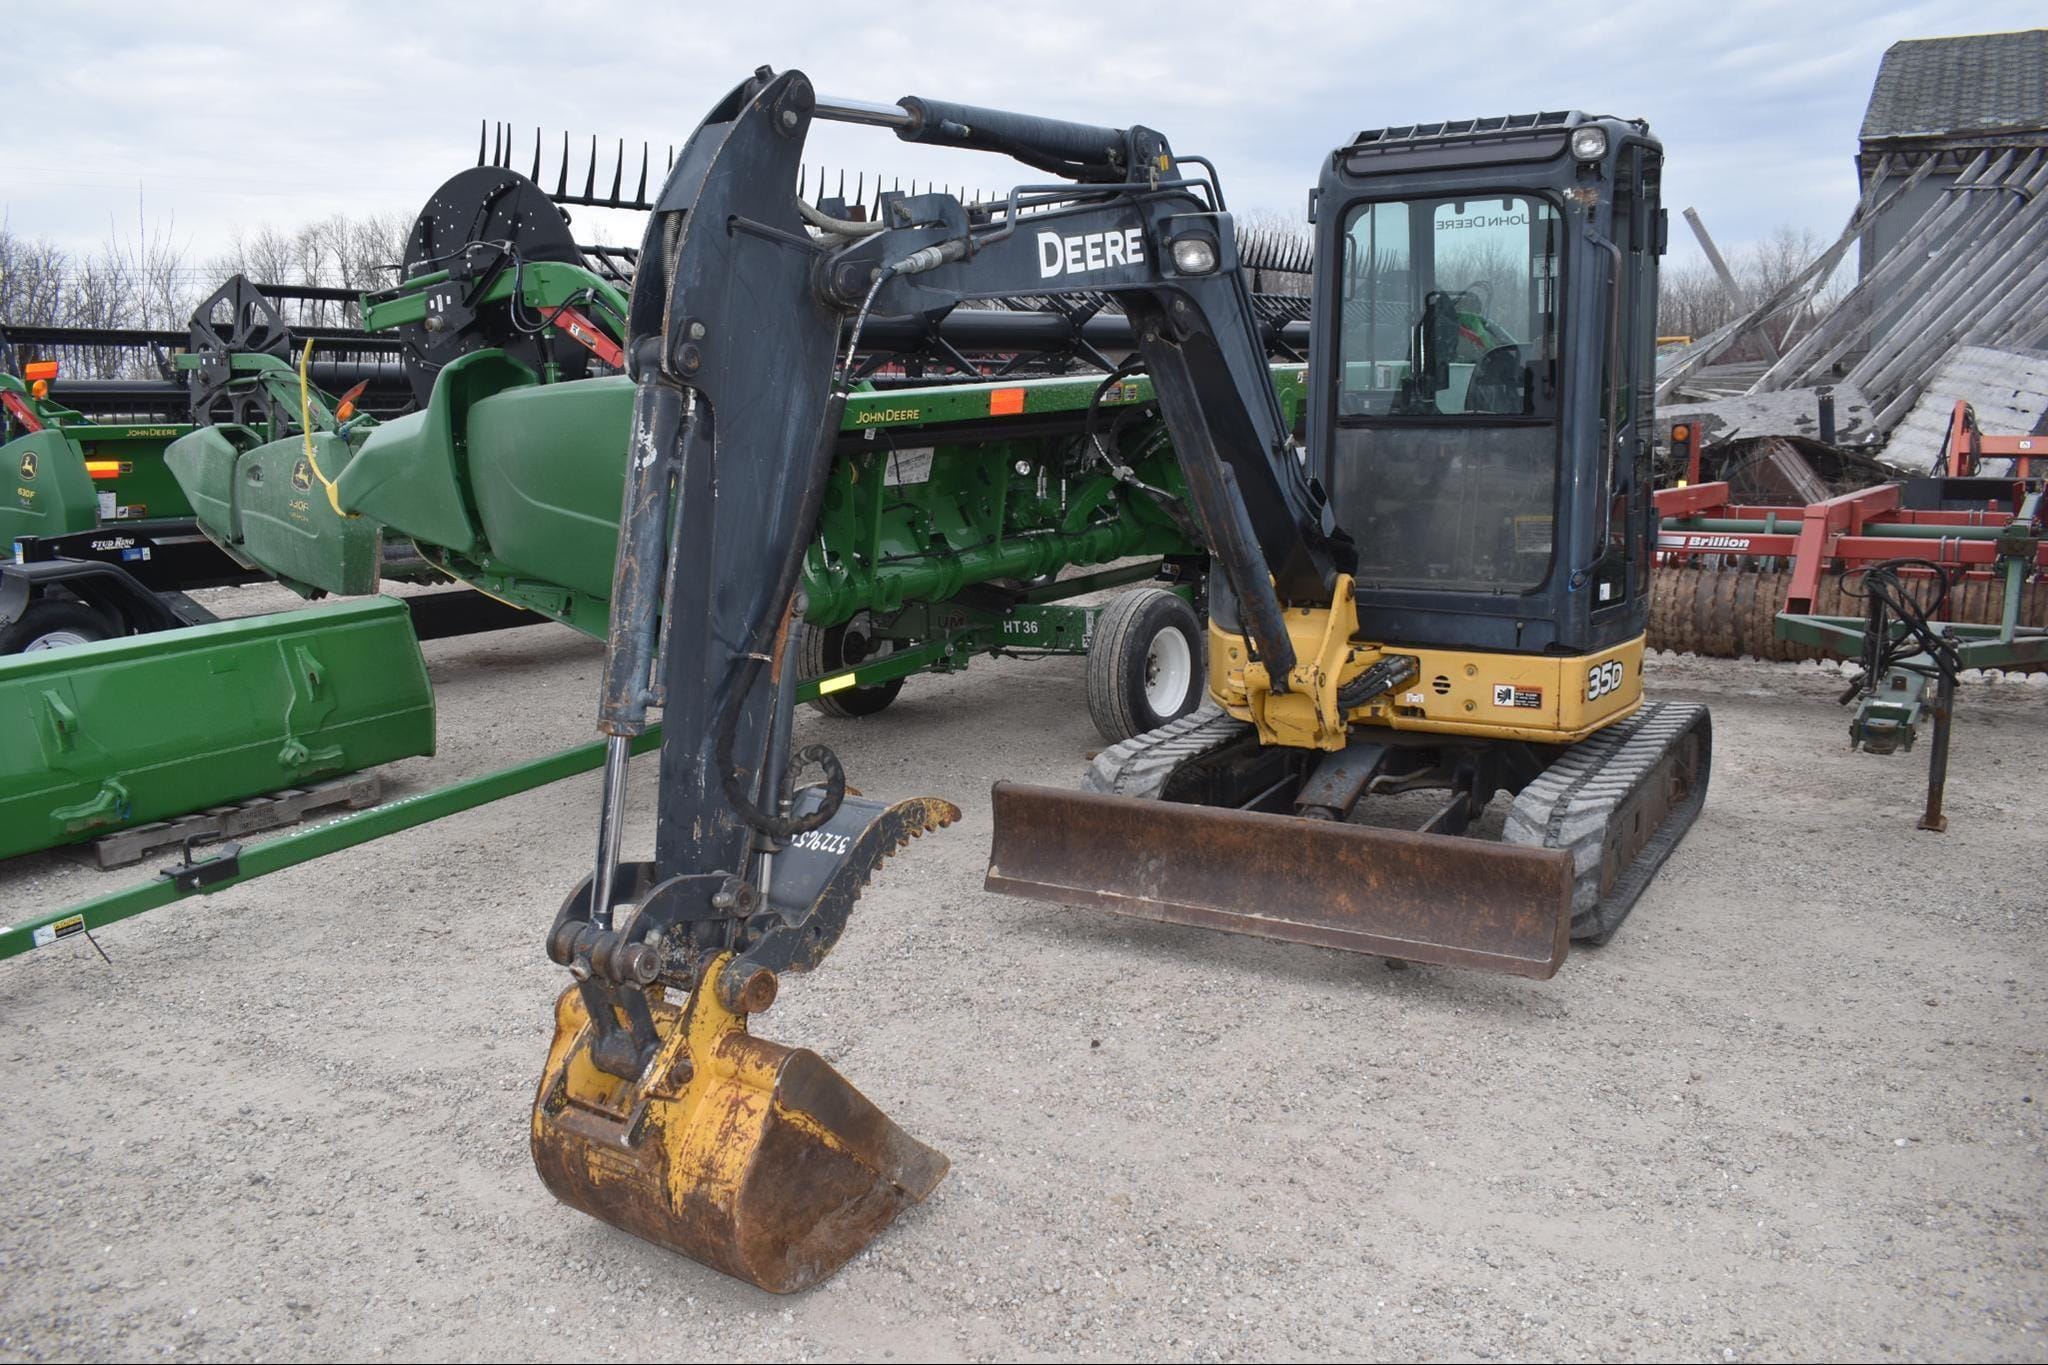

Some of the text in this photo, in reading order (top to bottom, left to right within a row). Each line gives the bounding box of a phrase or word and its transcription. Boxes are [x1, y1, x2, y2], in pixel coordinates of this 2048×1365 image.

[1037, 228, 1144, 278] DEERE
[856, 409, 920, 424] JOHN DEERE
[126, 428, 177, 437] JOHN DEERE
[1688, 536, 1750, 548] Brillion
[1588, 660, 1623, 700] 35D
